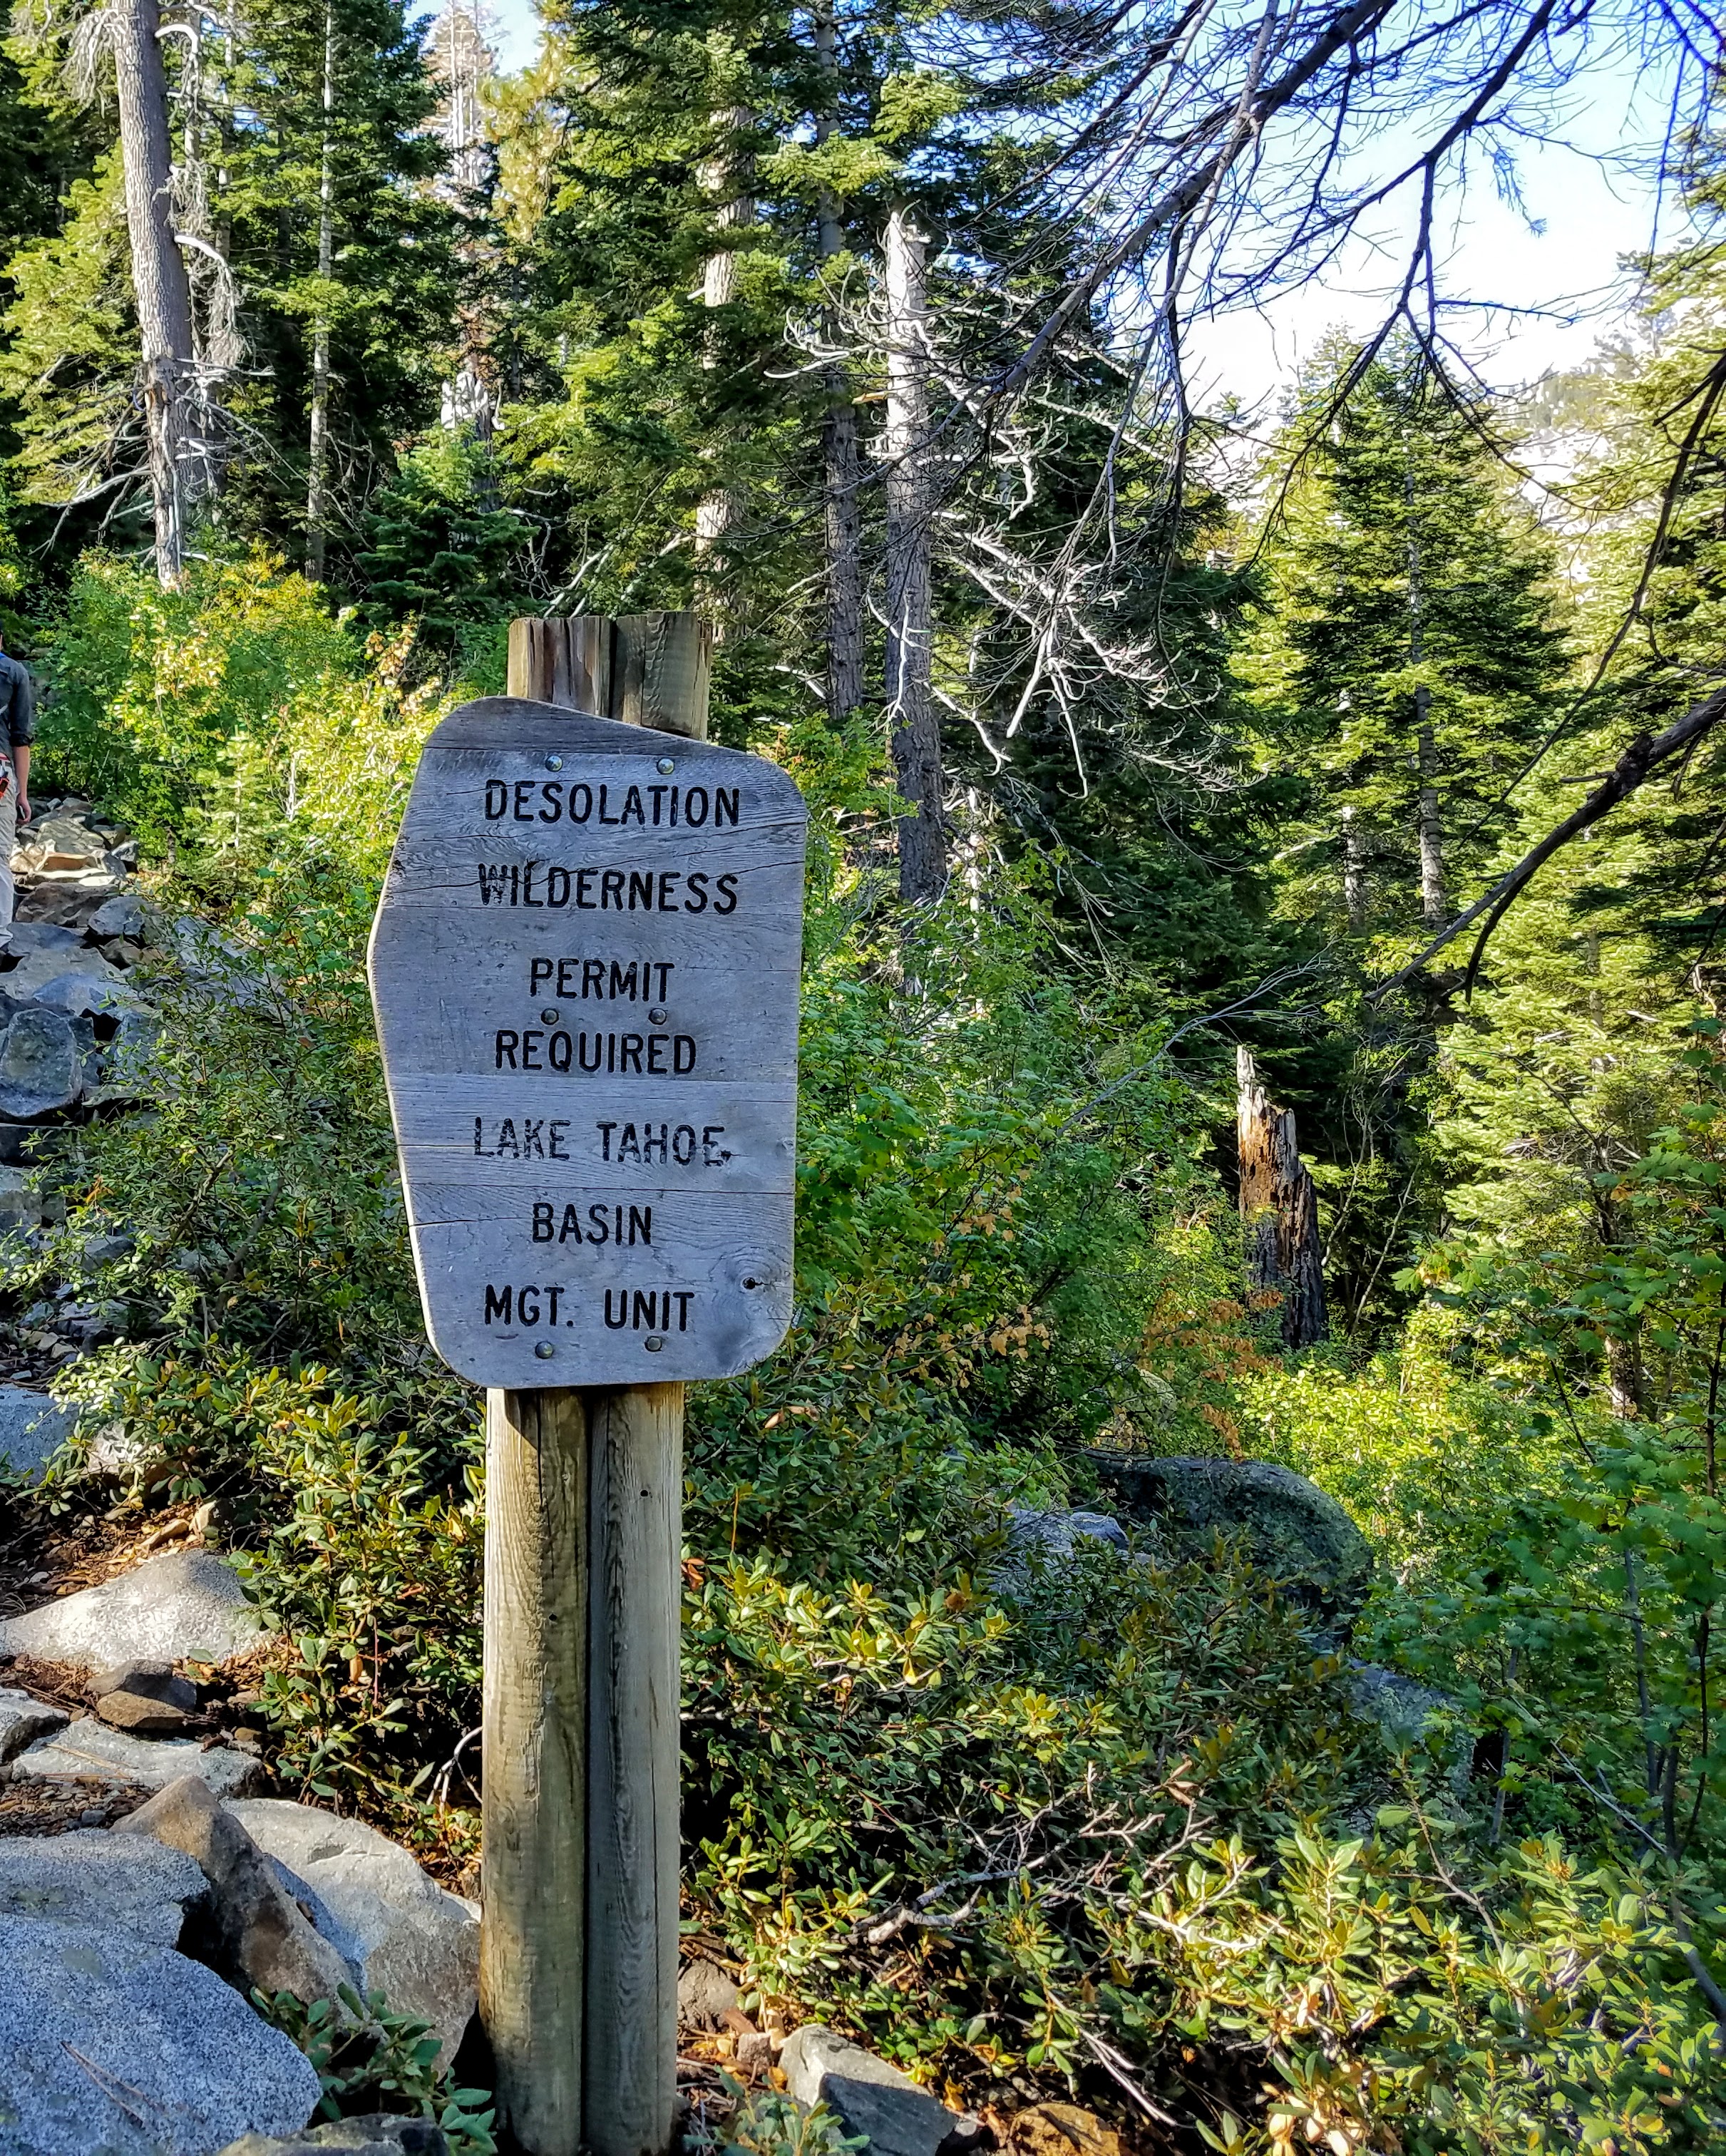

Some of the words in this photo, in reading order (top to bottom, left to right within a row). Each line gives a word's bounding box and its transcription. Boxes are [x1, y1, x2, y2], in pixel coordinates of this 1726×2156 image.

[486, 779, 740, 828] DESOLATION
[478, 862, 738, 915] WILDERNESS
[530, 958, 674, 1002] PERMIT
[495, 1030, 696, 1075] REQUIRED
[473, 1116, 571, 1161] LAKE
[596, 1121, 726, 1167] TAHOE
[533, 1203, 652, 1246] BASIN
[485, 1284, 574, 1327] MGT.
[605, 1289, 695, 1331] UNIT
